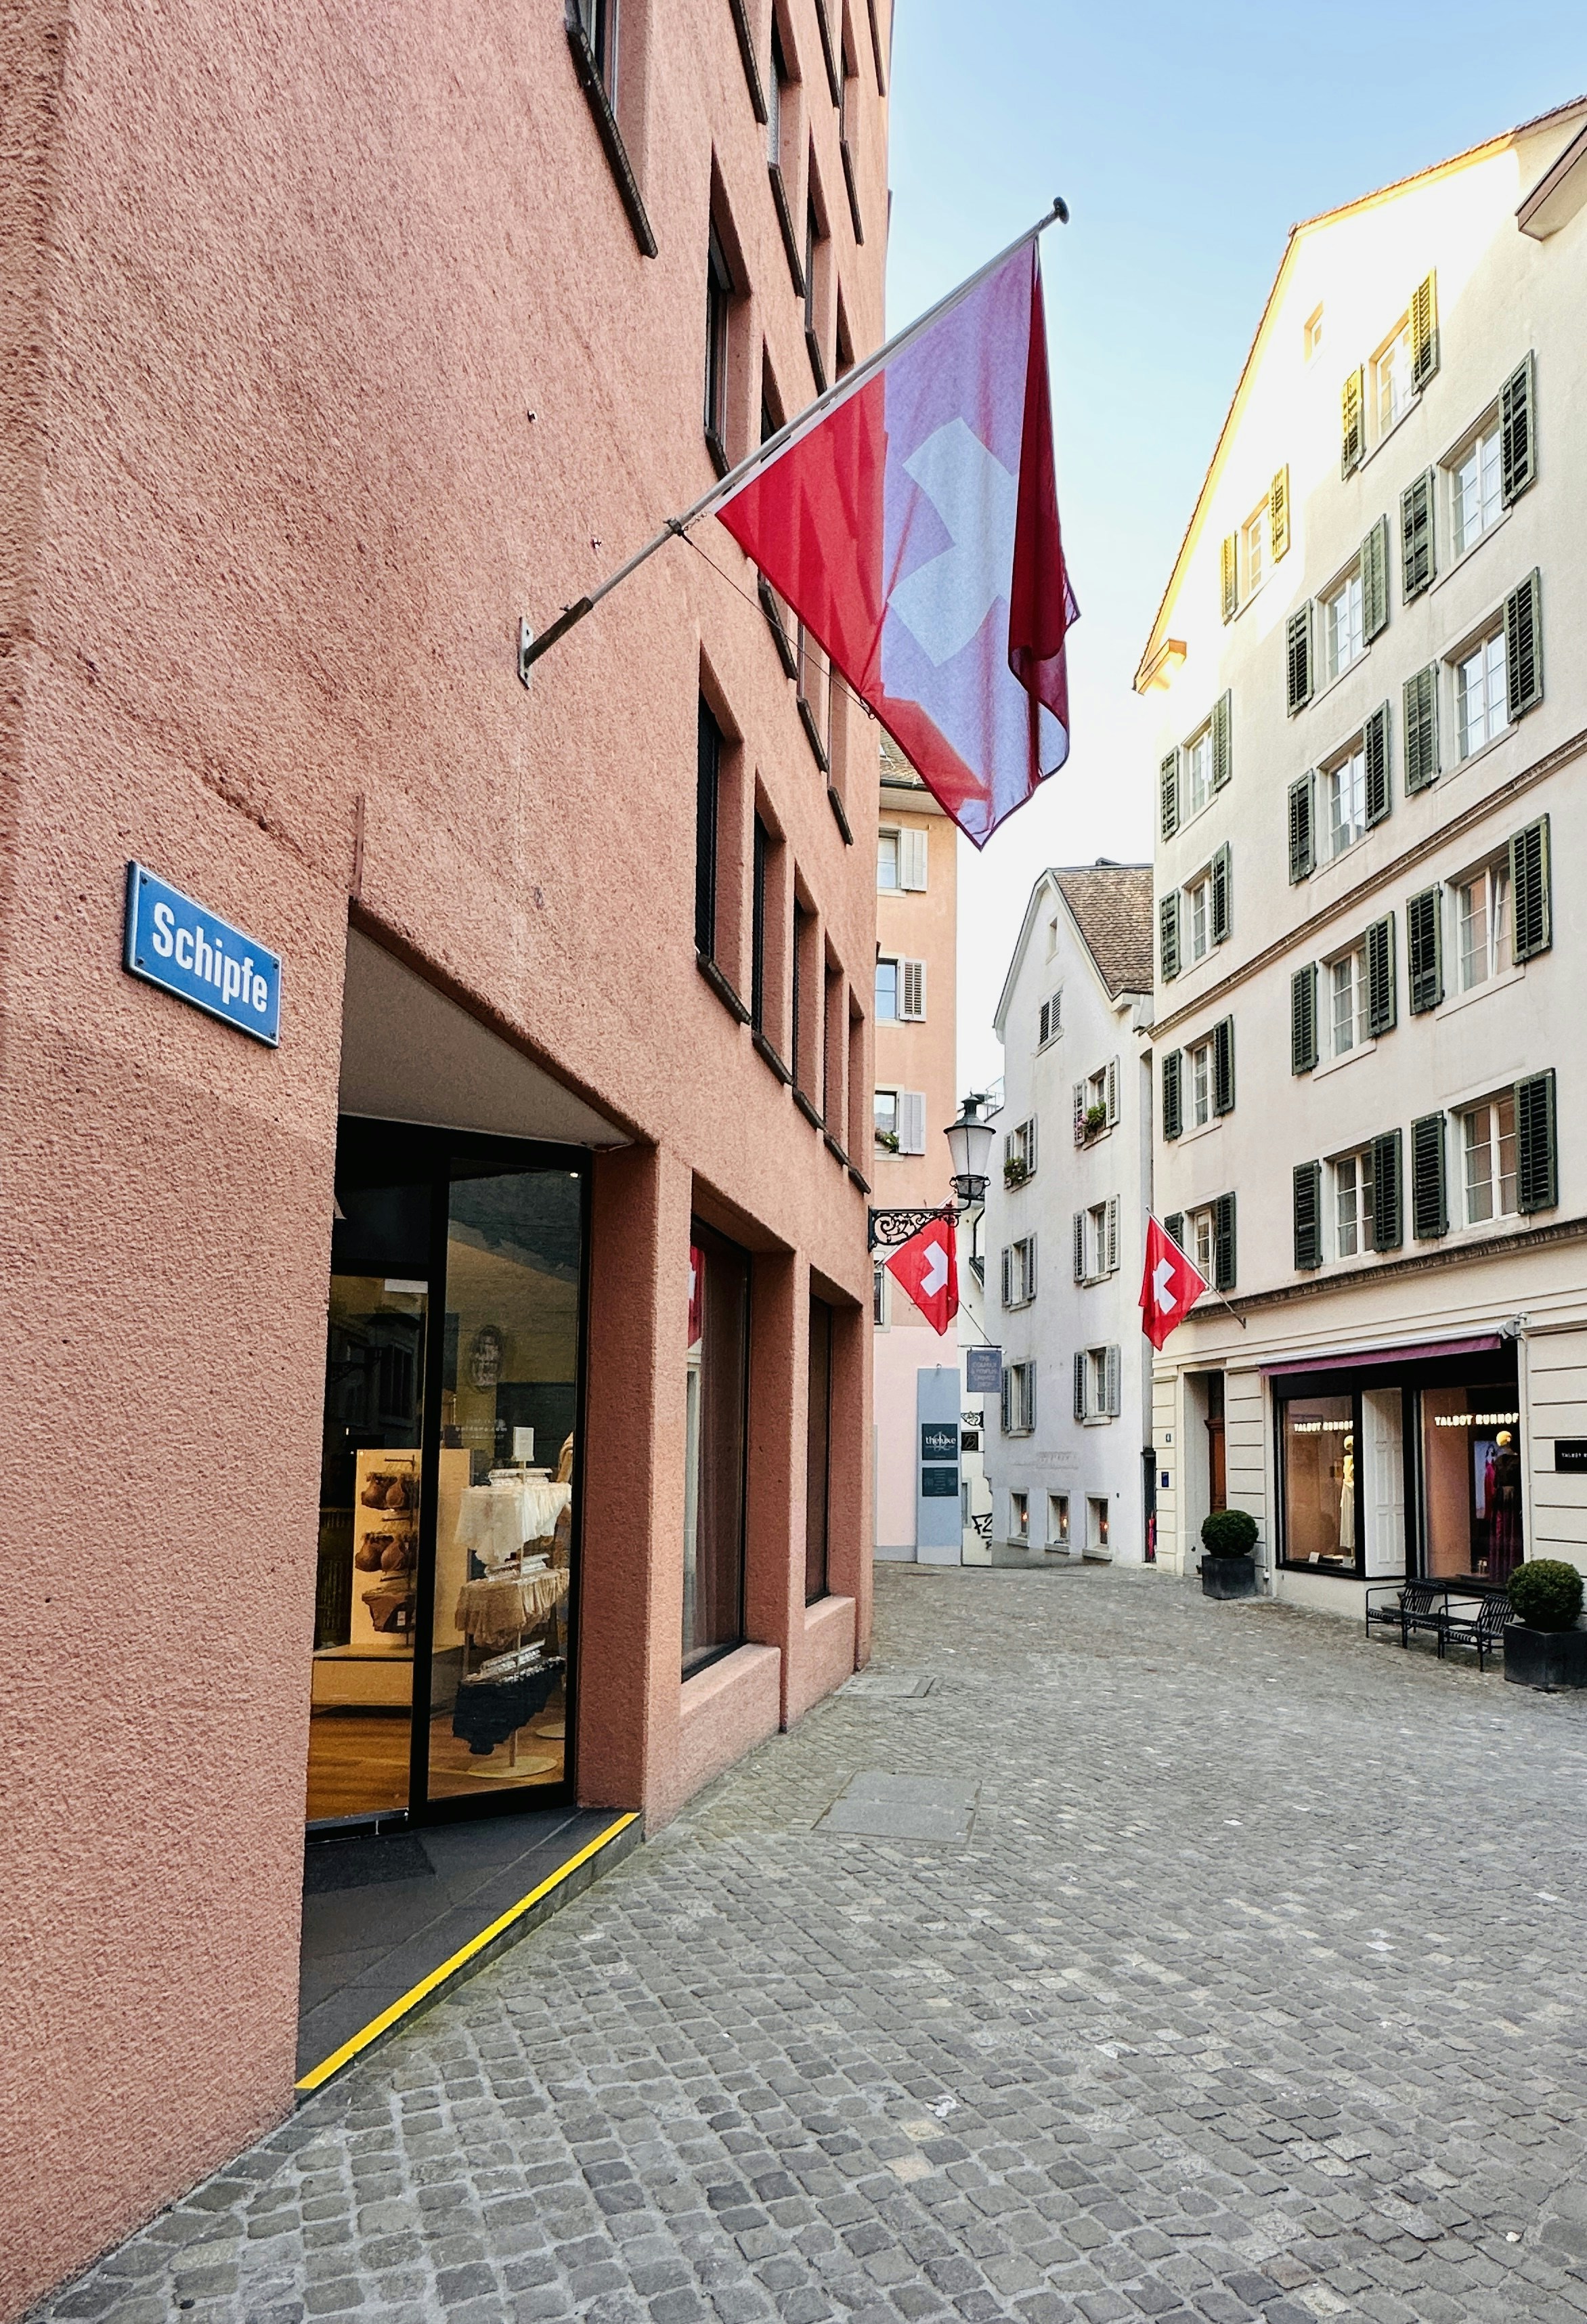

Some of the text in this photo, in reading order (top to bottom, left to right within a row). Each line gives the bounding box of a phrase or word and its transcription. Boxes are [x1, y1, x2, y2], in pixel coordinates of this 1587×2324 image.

[152, 902, 267, 1013] Schipfe
[1294, 1422, 1322, 1432] TALBOT
[1435, 1415, 1473, 1427] TALBOT
